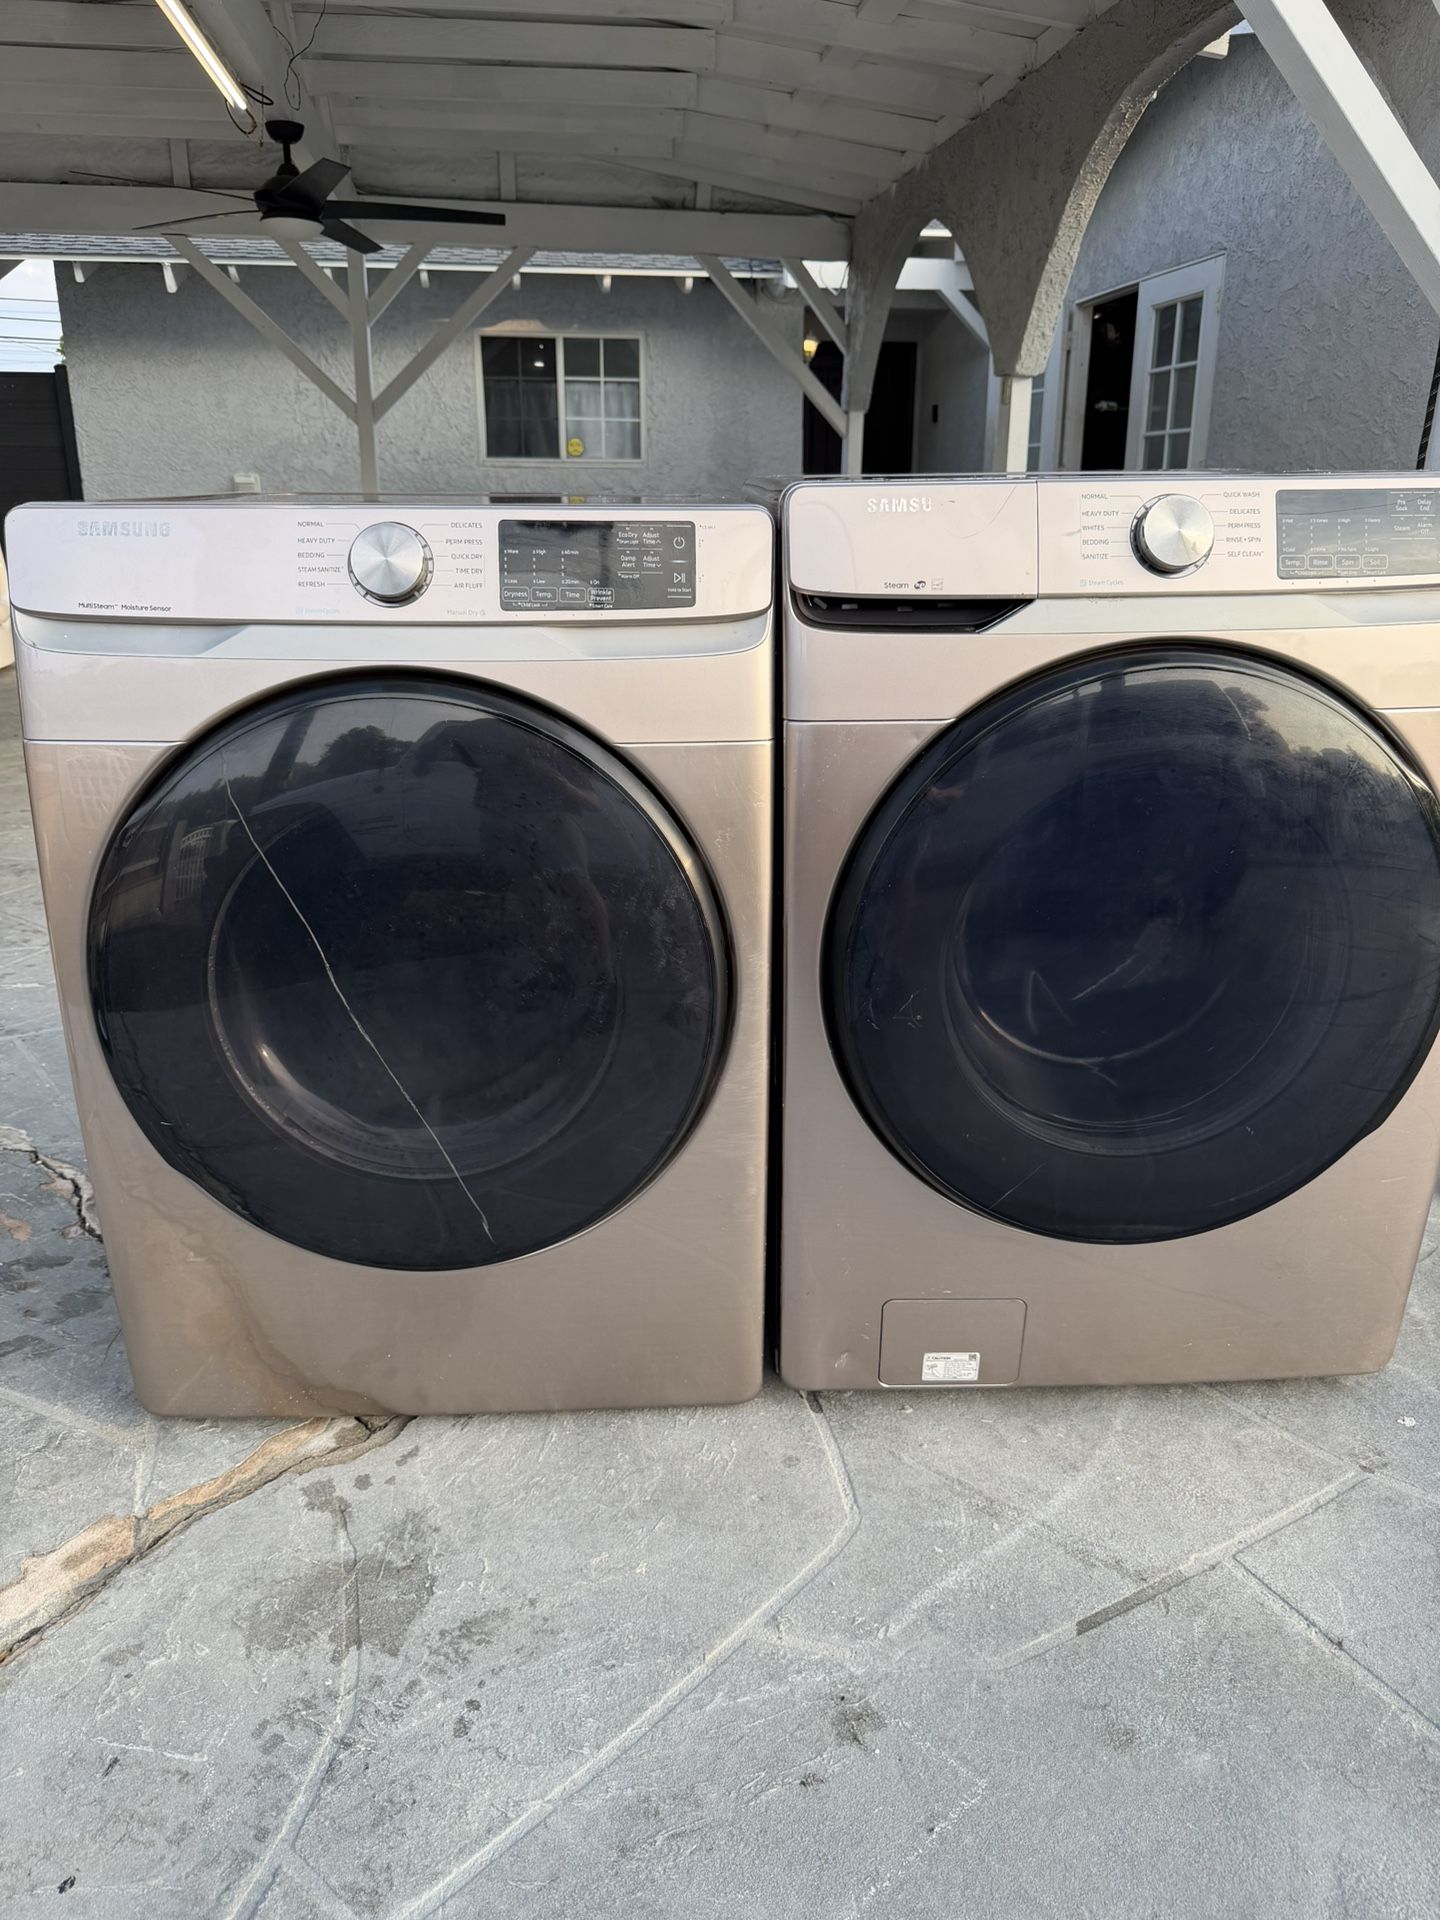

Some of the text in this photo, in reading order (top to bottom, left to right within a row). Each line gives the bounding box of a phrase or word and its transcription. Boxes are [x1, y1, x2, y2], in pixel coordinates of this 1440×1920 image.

[77, 520, 170, 537] SAMSUNG
[642, 532, 660, 540] Adjust
[642, 555, 660, 563] Adjust
[1342, 559, 1354, 567] Spin
[504, 590, 528, 599] Dryness
[566, 591, 580, 599] Time
[121, 603, 149, 612] Moisture
[149, 604, 172, 613] Sensor
